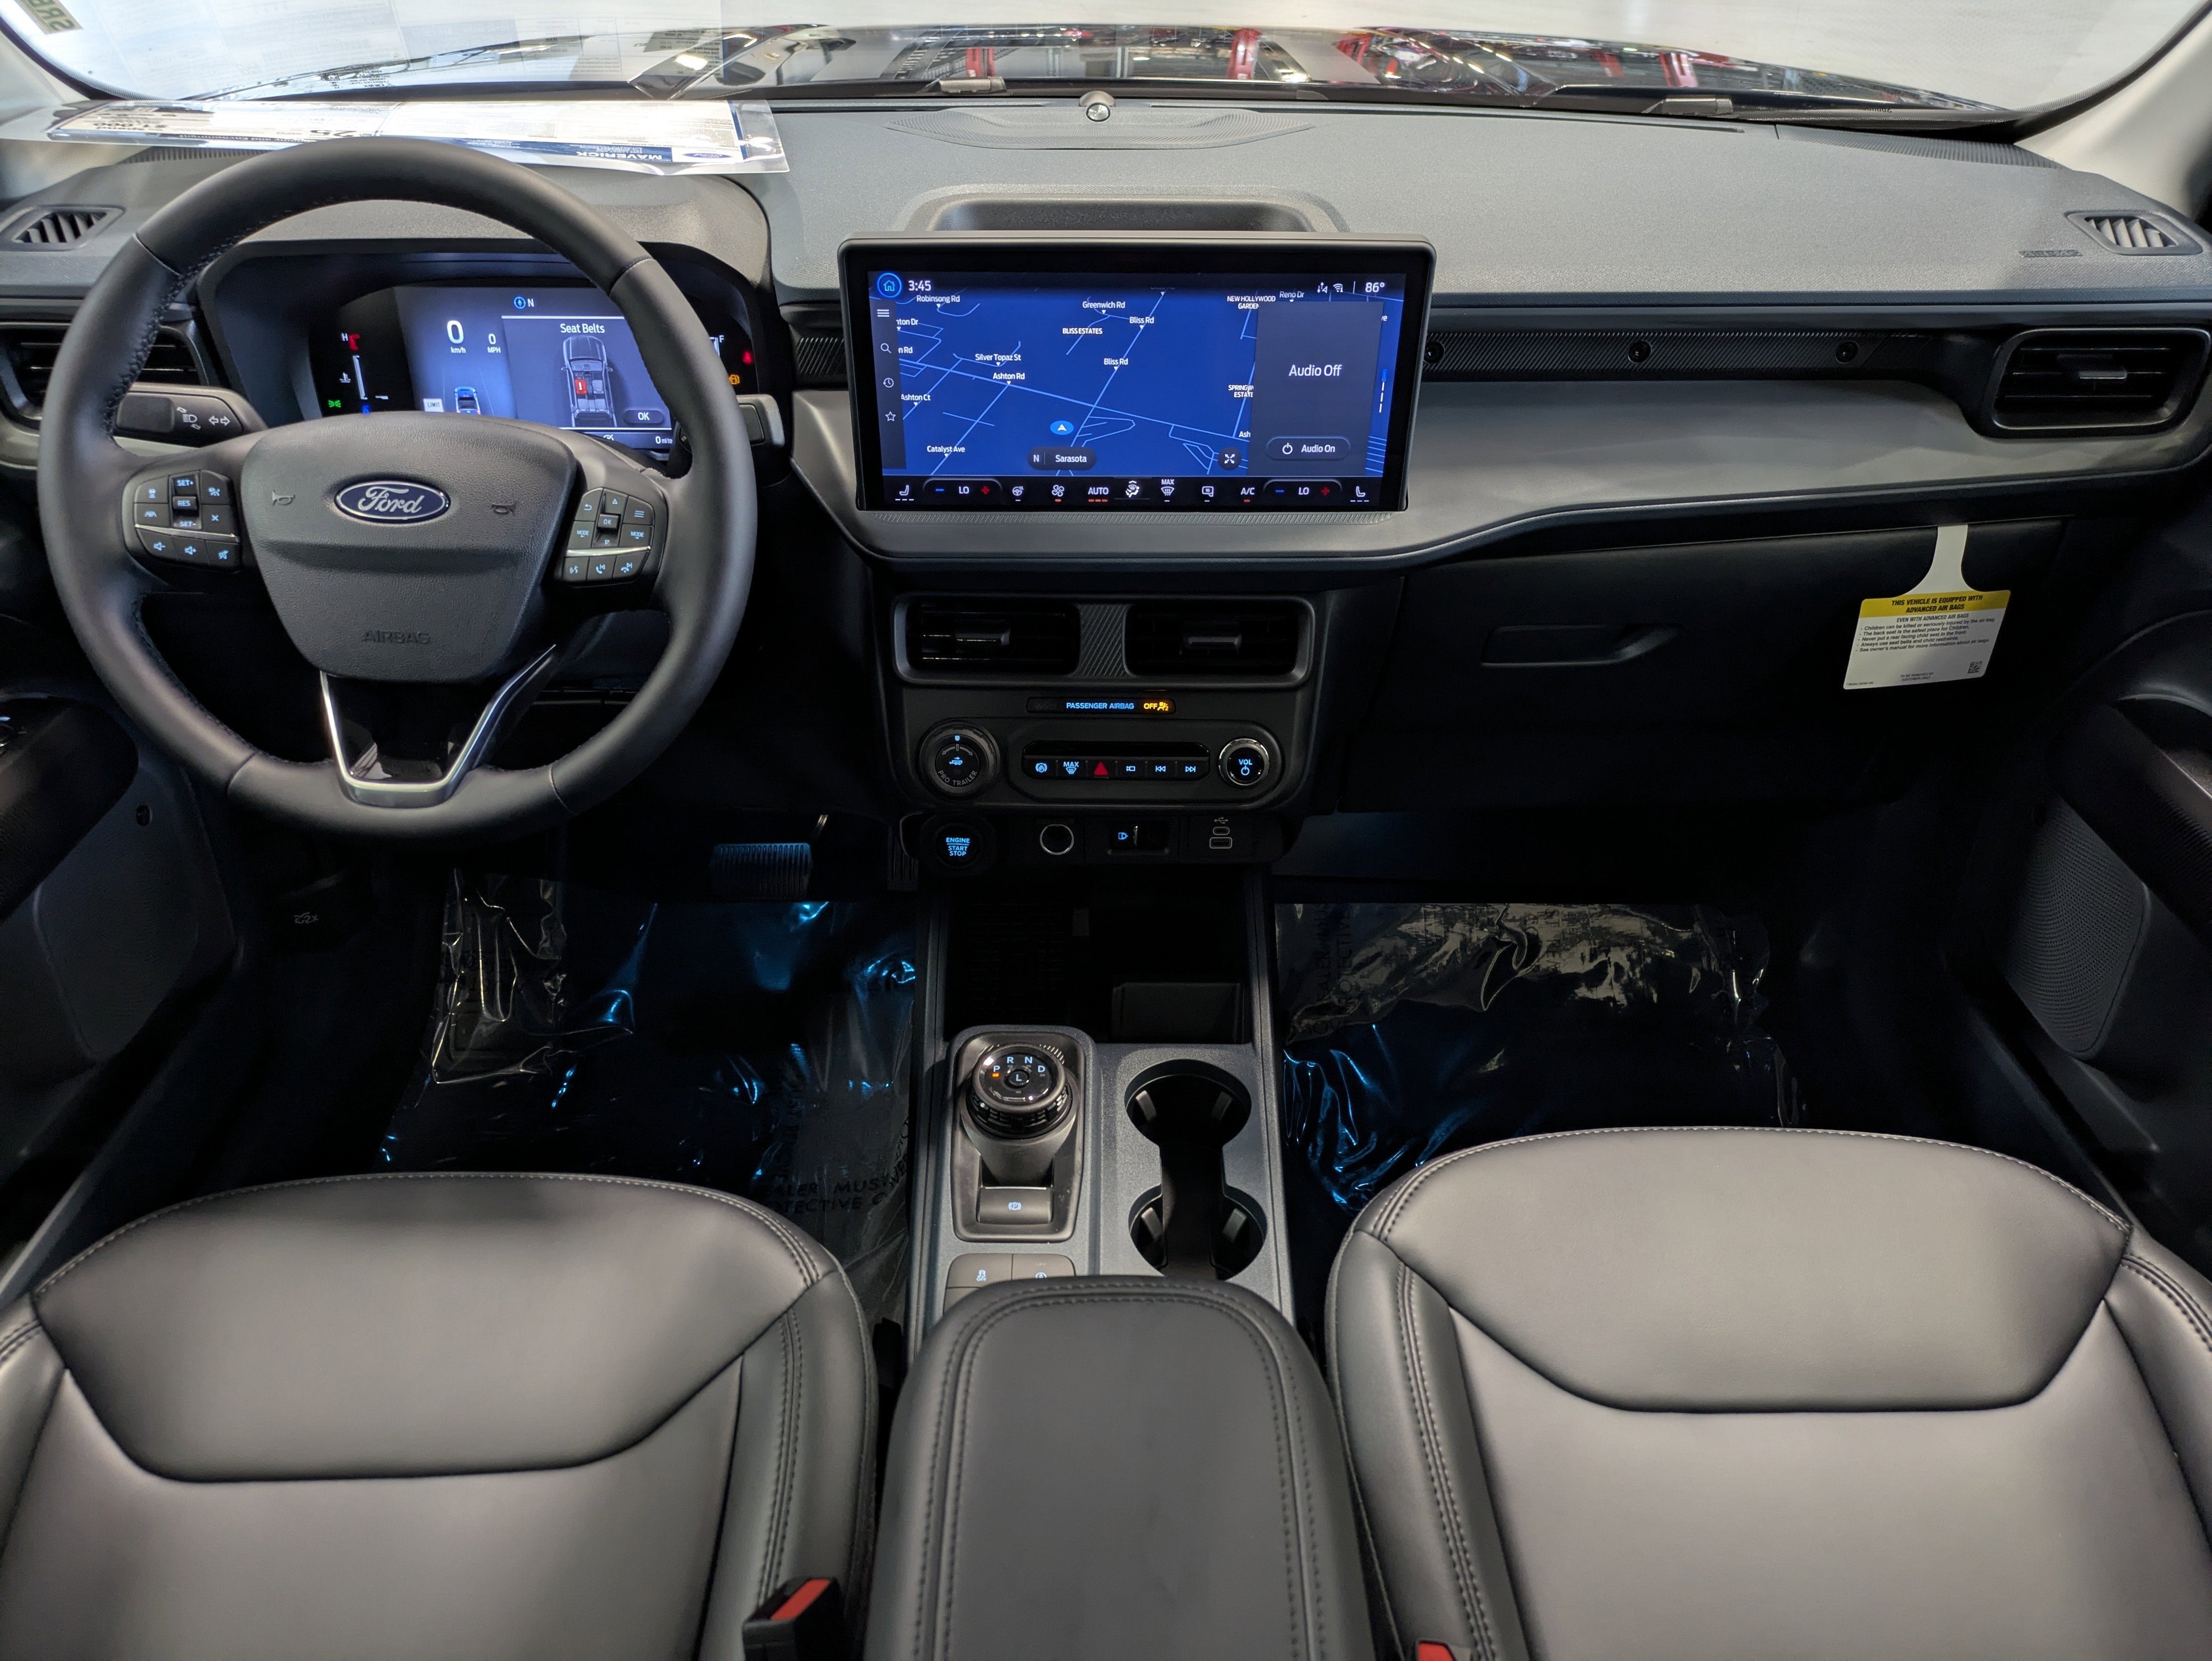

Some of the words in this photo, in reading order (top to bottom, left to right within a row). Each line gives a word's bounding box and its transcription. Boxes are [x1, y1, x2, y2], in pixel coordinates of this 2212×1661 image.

[310, 130, 357, 138] 25
[575, 151, 663, 160] MAVERICK
[908, 281, 931, 291] 3:45
[1365, 282, 1385, 293] 86°
[528, 299, 534, 307] N
[917, 295, 950, 303] Robinsong
[446, 320, 464, 344] 0
[560, 323, 581, 334] Seat
[582, 323, 605, 334] Belts
[341, 332, 349, 341] H
[488, 333, 497, 345] 0
[994, 354, 1013, 362] Topaz
[1289, 365, 1322, 377] Audio
[1324, 365, 1342, 377] Off
[638, 412, 650, 421] OK
[655, 436, 661, 444] 0
[927, 445, 952, 454] Catalyst
[1301, 444, 1322, 453] Audio
[1323, 444, 1336, 453] On
[1055, 454, 1087, 463] Sarasota
[959, 486, 969, 494] LO
[1088, 487, 1109, 495] AUTO
[1240, 487, 1255, 495] A/C
[358, 486, 425, 514] Ford
[362, 630, 431, 644] AIRBAG
[938, 770, 951, 783] PRO
[952, 770, 978, 786] TRAILER
